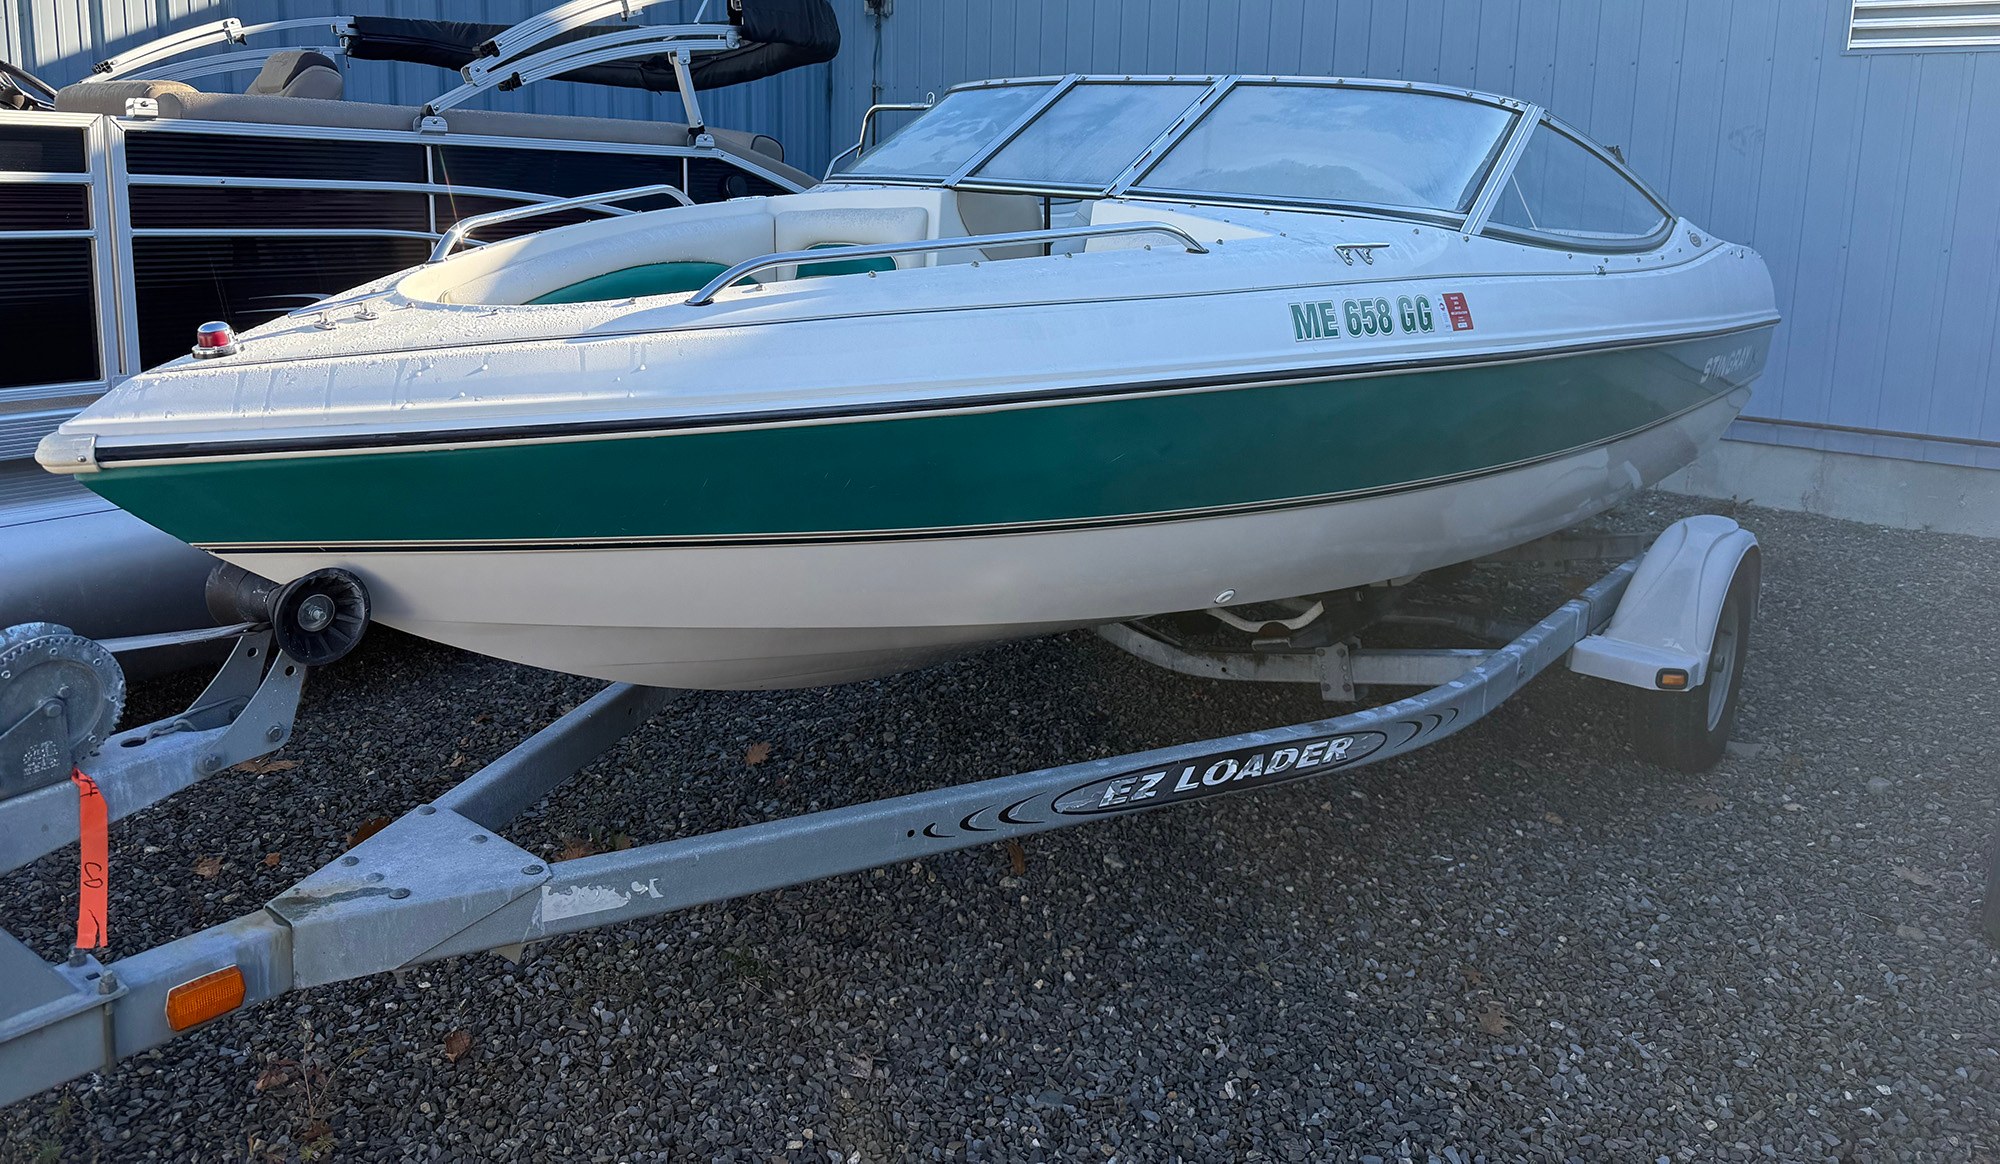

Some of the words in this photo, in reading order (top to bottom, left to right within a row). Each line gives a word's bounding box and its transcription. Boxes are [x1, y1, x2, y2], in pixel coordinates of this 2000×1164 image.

[1289, 300, 1341, 342] ME
[1343, 297, 1394, 338] 658
[1397, 295, 1434, 334] GG
[1700, 344, 1753, 383] STINGRAY
[1098, 771, 1167, 808] EZ
[1173, 737, 1354, 792] LOADER
